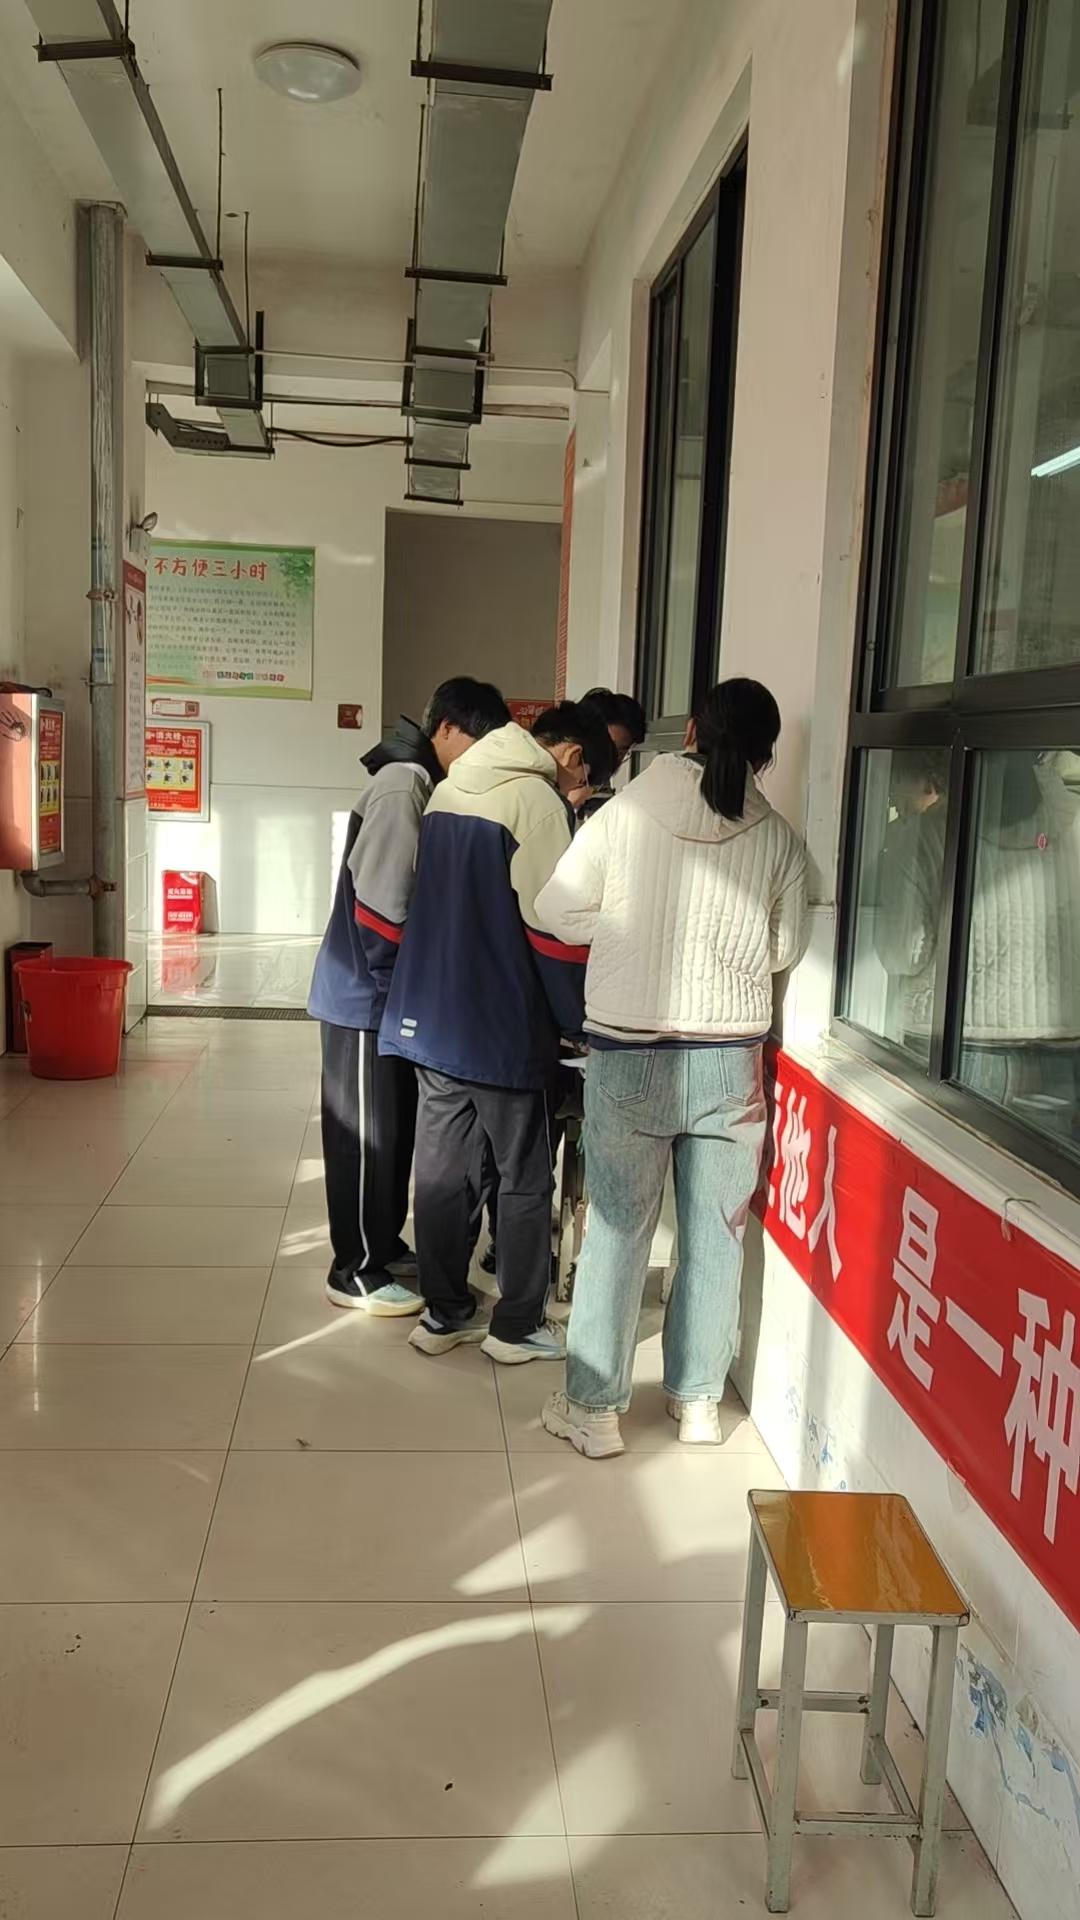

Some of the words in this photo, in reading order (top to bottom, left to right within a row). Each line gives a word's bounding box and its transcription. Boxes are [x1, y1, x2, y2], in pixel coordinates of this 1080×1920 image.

[145, 557, 267, 581] 不方便三小时
[769, 1081, 842, 1283] 他人
[887, 1186, 1080, 1544] 是一种
